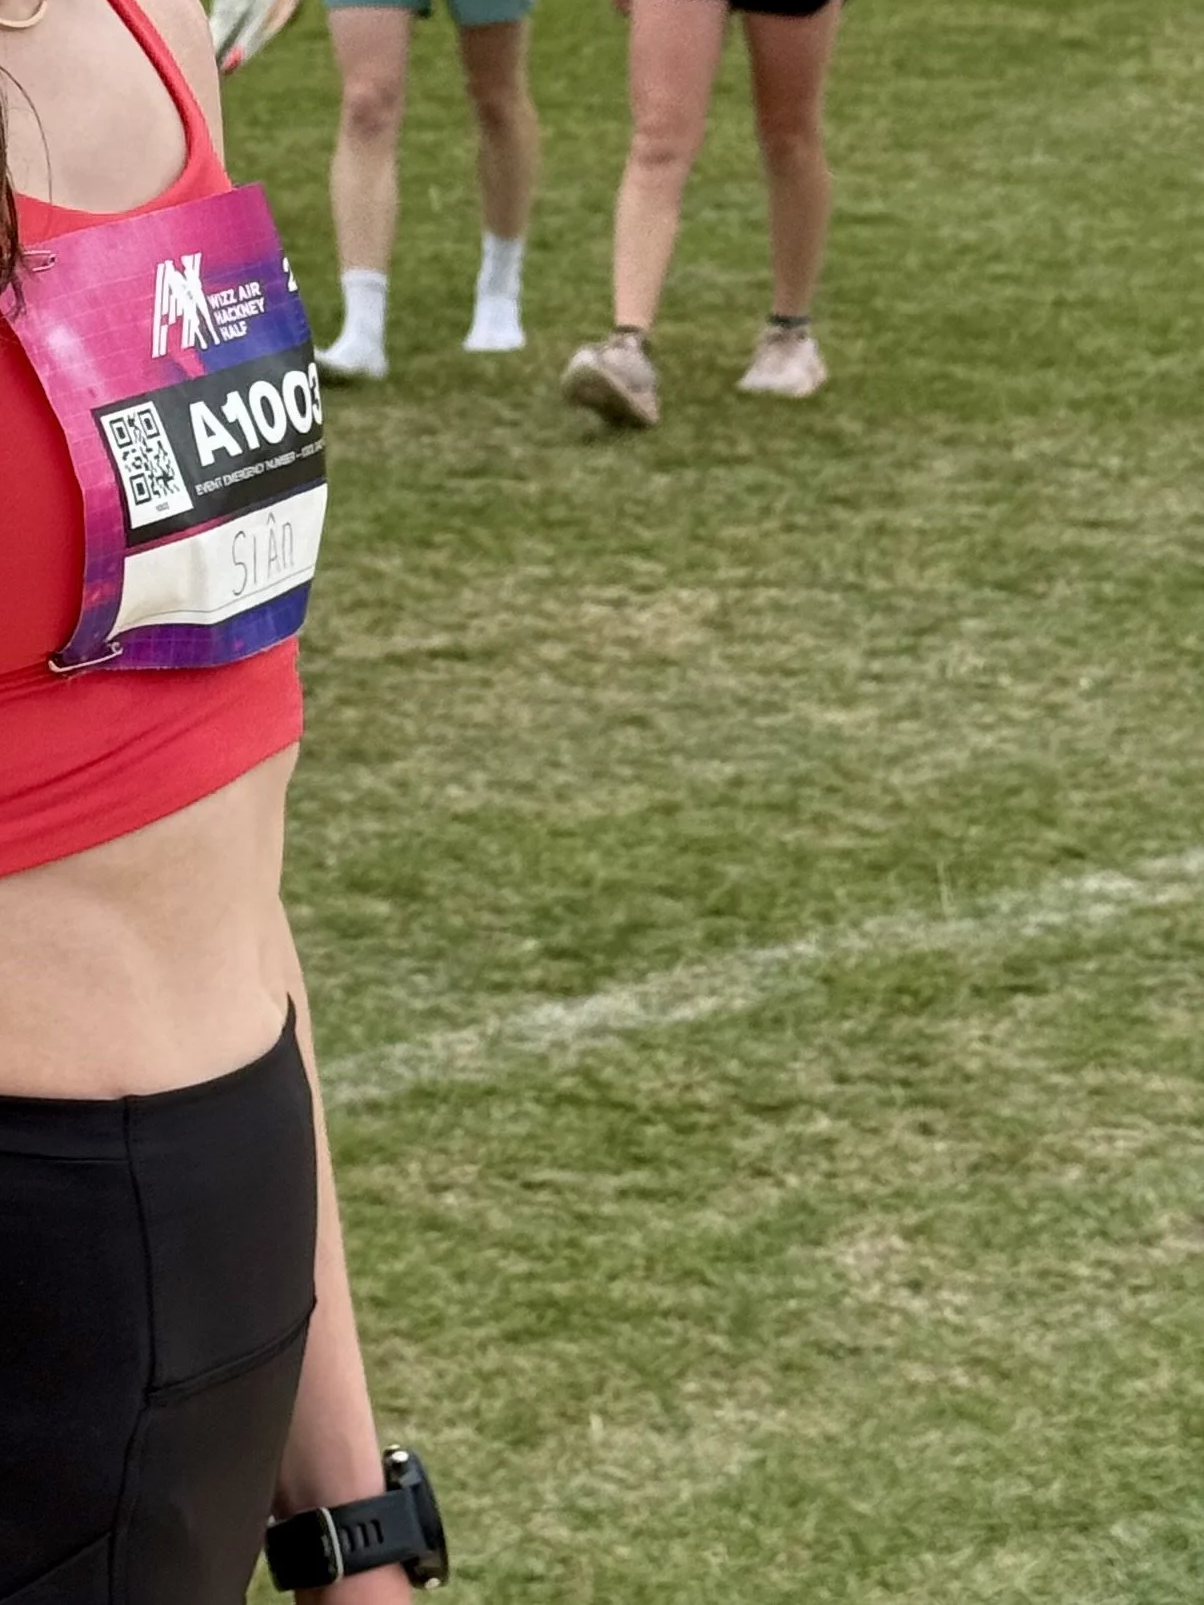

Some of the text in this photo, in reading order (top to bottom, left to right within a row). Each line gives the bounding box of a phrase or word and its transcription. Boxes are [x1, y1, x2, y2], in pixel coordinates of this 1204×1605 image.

[207, 282, 261, 309] WIZZ AIR
[213, 297, 264, 325] HACKNEY
[219, 320, 249, 341] HALF
